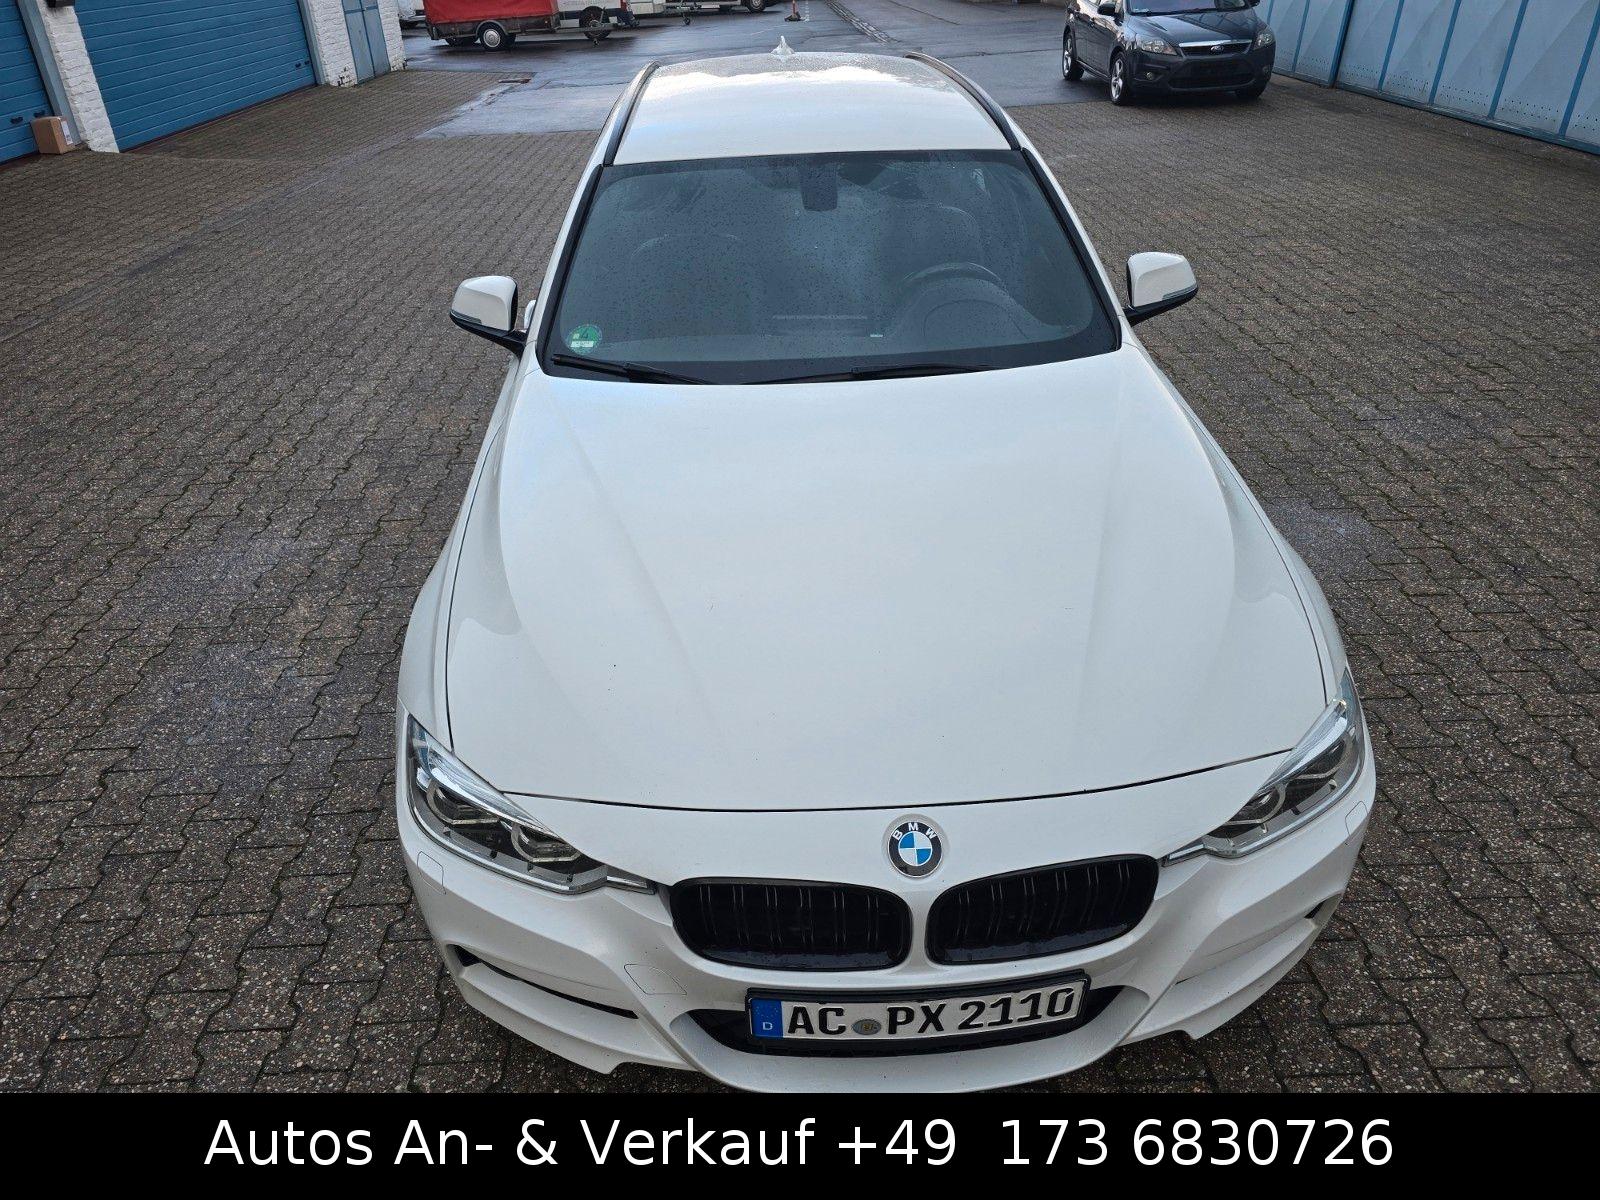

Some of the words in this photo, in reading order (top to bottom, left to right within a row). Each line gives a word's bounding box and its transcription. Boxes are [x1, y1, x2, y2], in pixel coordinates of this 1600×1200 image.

[892, 822, 936, 840] BMW
[788, 1006, 847, 1036] AC
[887, 1003, 947, 1035] PX
[957, 987, 1075, 1031] 2110
[762, 1021, 773, 1031] D
